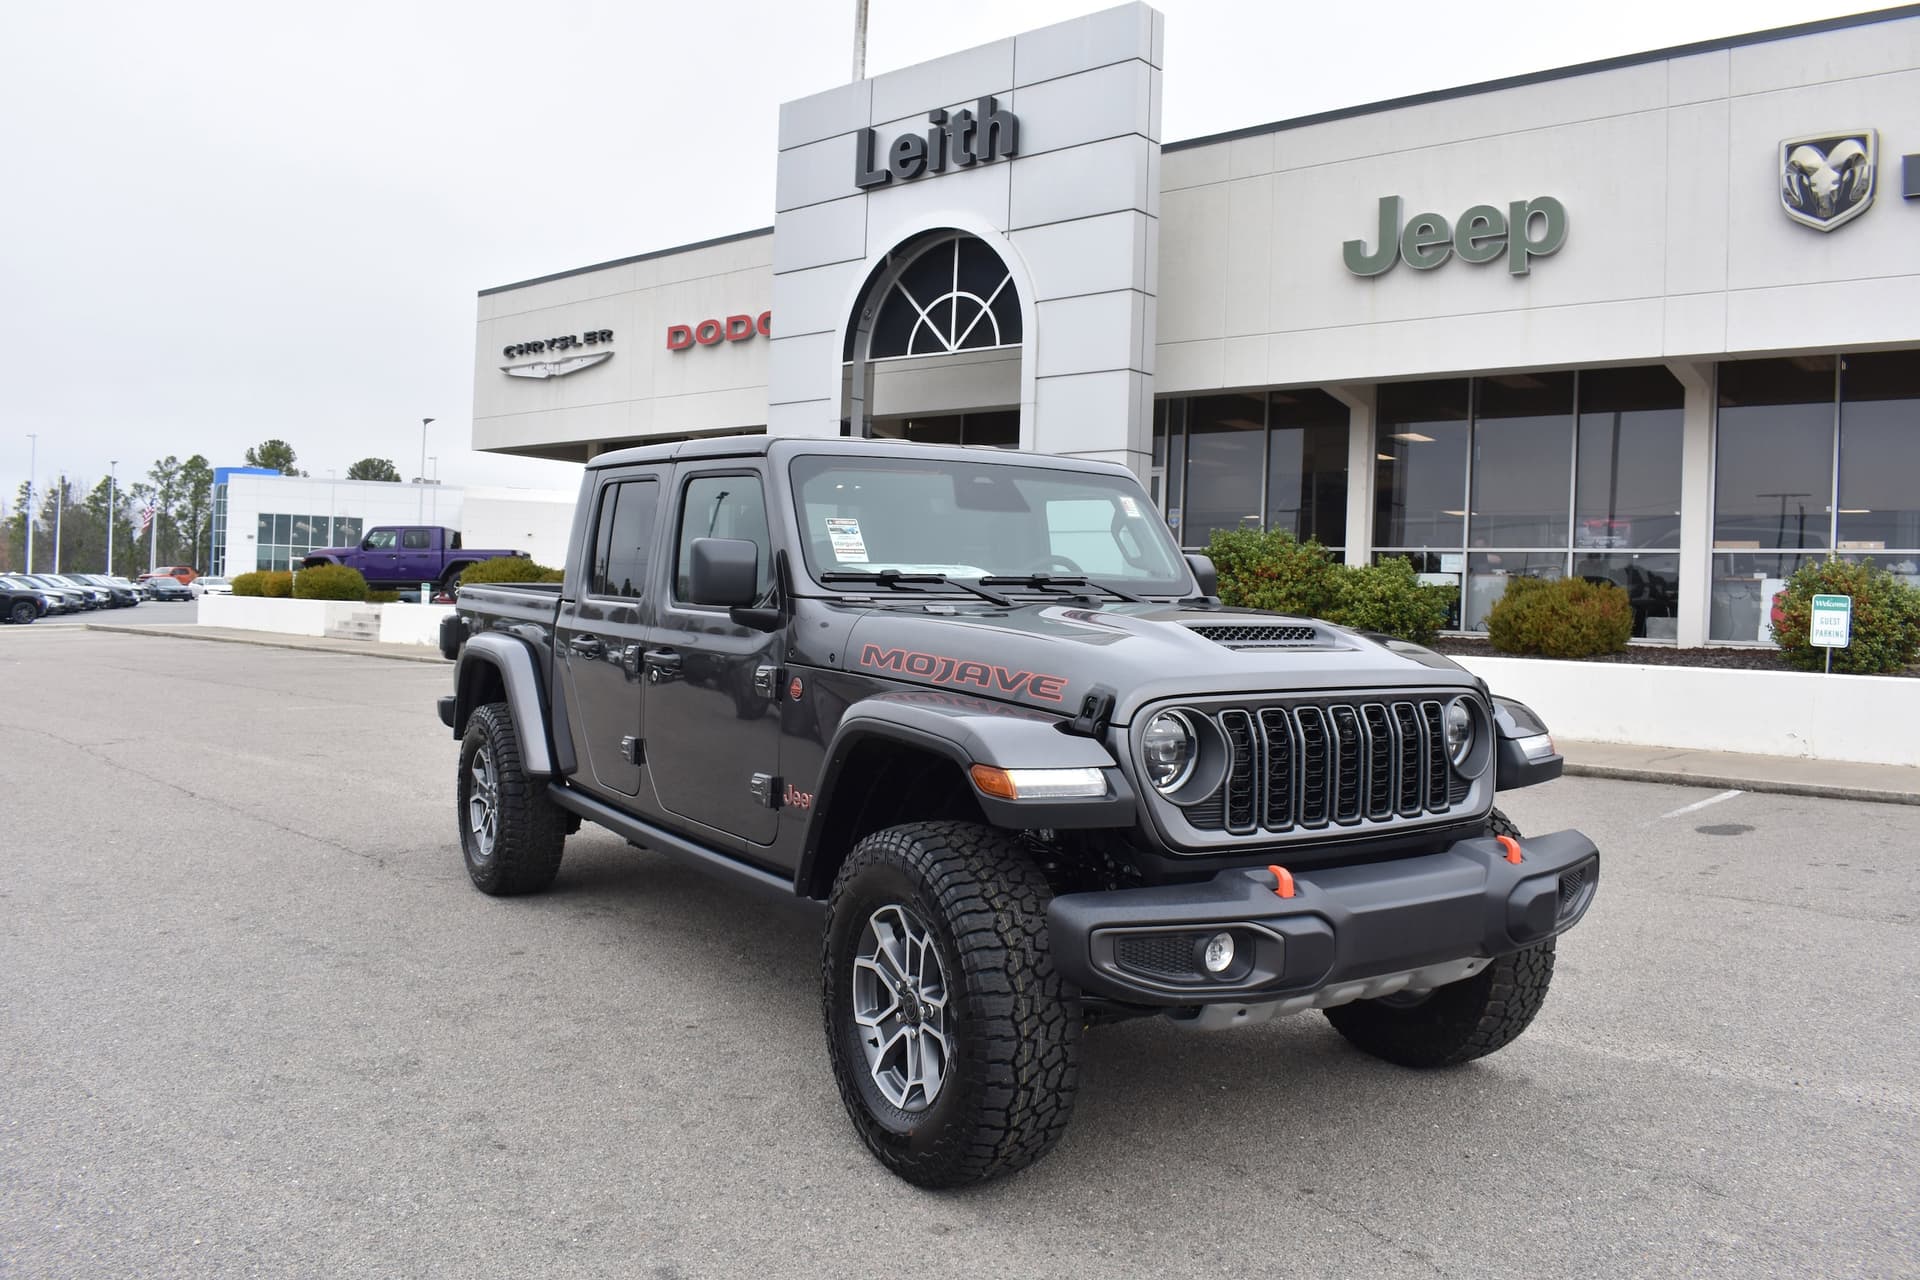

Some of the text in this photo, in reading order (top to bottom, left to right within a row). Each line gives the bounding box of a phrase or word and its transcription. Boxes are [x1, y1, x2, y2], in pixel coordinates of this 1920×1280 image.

[855, 95, 1019, 189] Leith
[1343, 195, 1569, 277] Jeep
[503, 329, 614, 359] CHRYSLER
[1815, 599, 1848, 608] Welcome
[1815, 629, 1845, 638] PARKING
[1820, 617, 1841, 626] GUEST
[860, 643, 1069, 702] MOJAVE
